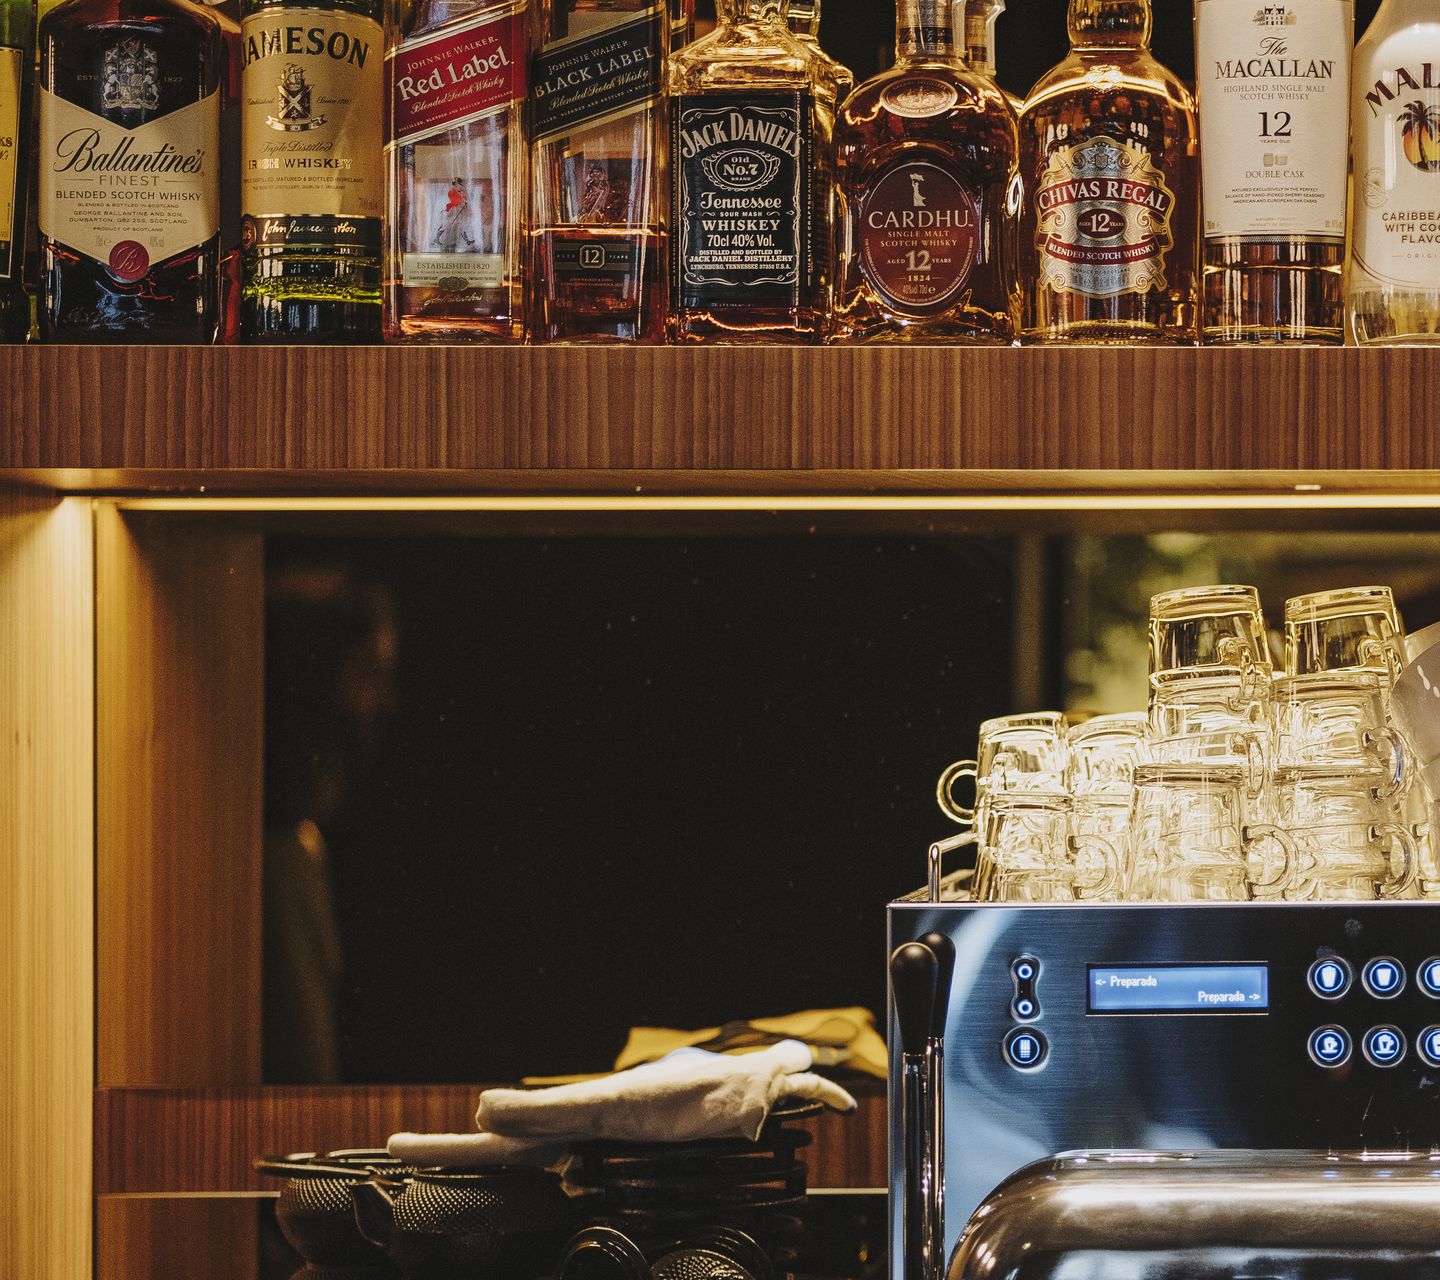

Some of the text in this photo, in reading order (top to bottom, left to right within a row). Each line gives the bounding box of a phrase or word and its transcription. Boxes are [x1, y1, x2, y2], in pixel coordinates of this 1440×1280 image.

[241, 26, 369, 71] JAMESON
[1256, 36, 1288, 57] The
[406, 36, 495, 75] JOHNNIE WALKER
[548, 40, 629, 76] JOHNNIE WALKER
[396, 45, 511, 102] Red Label
[534, 45, 656, 99] BLACK LABEL
[1215, 60, 1333, 81] MACALLAN
[1223, 84, 1326, 94] HIGHLAND SINGLE MALT
[1239, 92, 1311, 101] SCOTCH WHISKY
[1258, 111, 1292, 138] 12
[681, 120, 729, 159] JACK
[53, 127, 206, 174] Ballantine's
[284, 158, 354, 170] WHISKEY
[731, 156, 751, 164] Old
[722, 163, 760, 177] No.7
[1245, 169, 1306, 180] DOUBLE CASK
[99, 175, 160, 187] FINEST
[55, 190, 202, 202] BLENDED SCOTCH WHISKY
[700, 191, 783, 210] Tennessee
[1039, 181, 1167, 212] CHIVAS REGAL
[701, 219, 782, 232] WHISKEY
[868, 209, 970, 229] CARDHU
[1090, 213, 1110, 232] 12
[887, 230, 951, 238] SINGLE MALT
[1385, 223, 1416, 234] WITH
[706, 233, 776, 247] 70cl 40% Vol.
[880, 239, 959, 248] SCOTCH WHISKY
[583, 249, 600, 265] 12
[689, 254, 794, 263] JACK DANIEL DISTILLERY
[1048, 242, 1156, 260] BLENDED SCOTCH WHISKY
[416, 261, 490, 270] ESTABLISHED 1820
[905, 249, 932, 272] 12
[1109, 974, 1158, 989] Preparada
[1197, 989, 1246, 1004] Preparada
